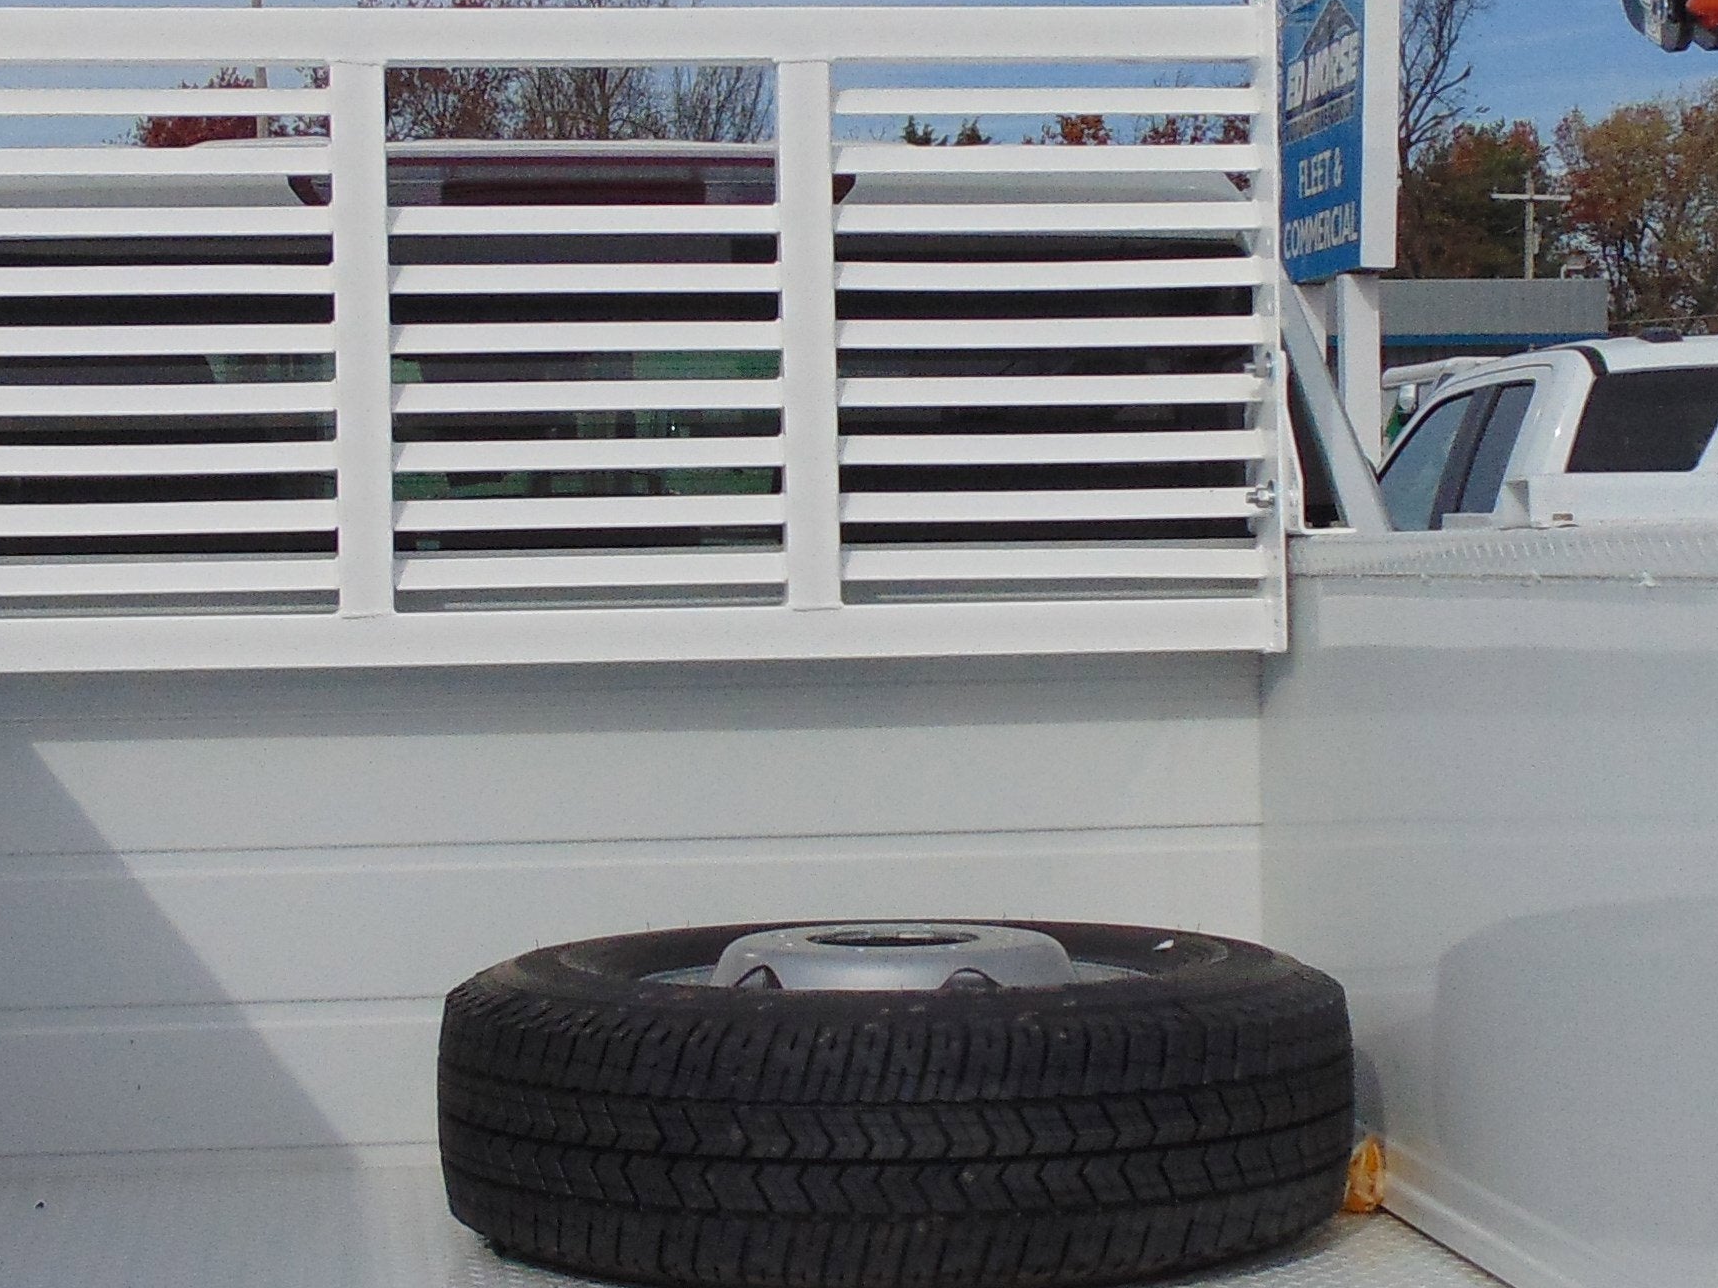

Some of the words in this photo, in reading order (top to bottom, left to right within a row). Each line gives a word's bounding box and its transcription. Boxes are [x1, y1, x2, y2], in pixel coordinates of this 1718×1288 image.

[1286, 61, 1305, 110] ED
[1306, 30, 1359, 102] MORSE
[1298, 148, 1331, 199] FLEET
[1284, 200, 1358, 259] COMMERCIAL
